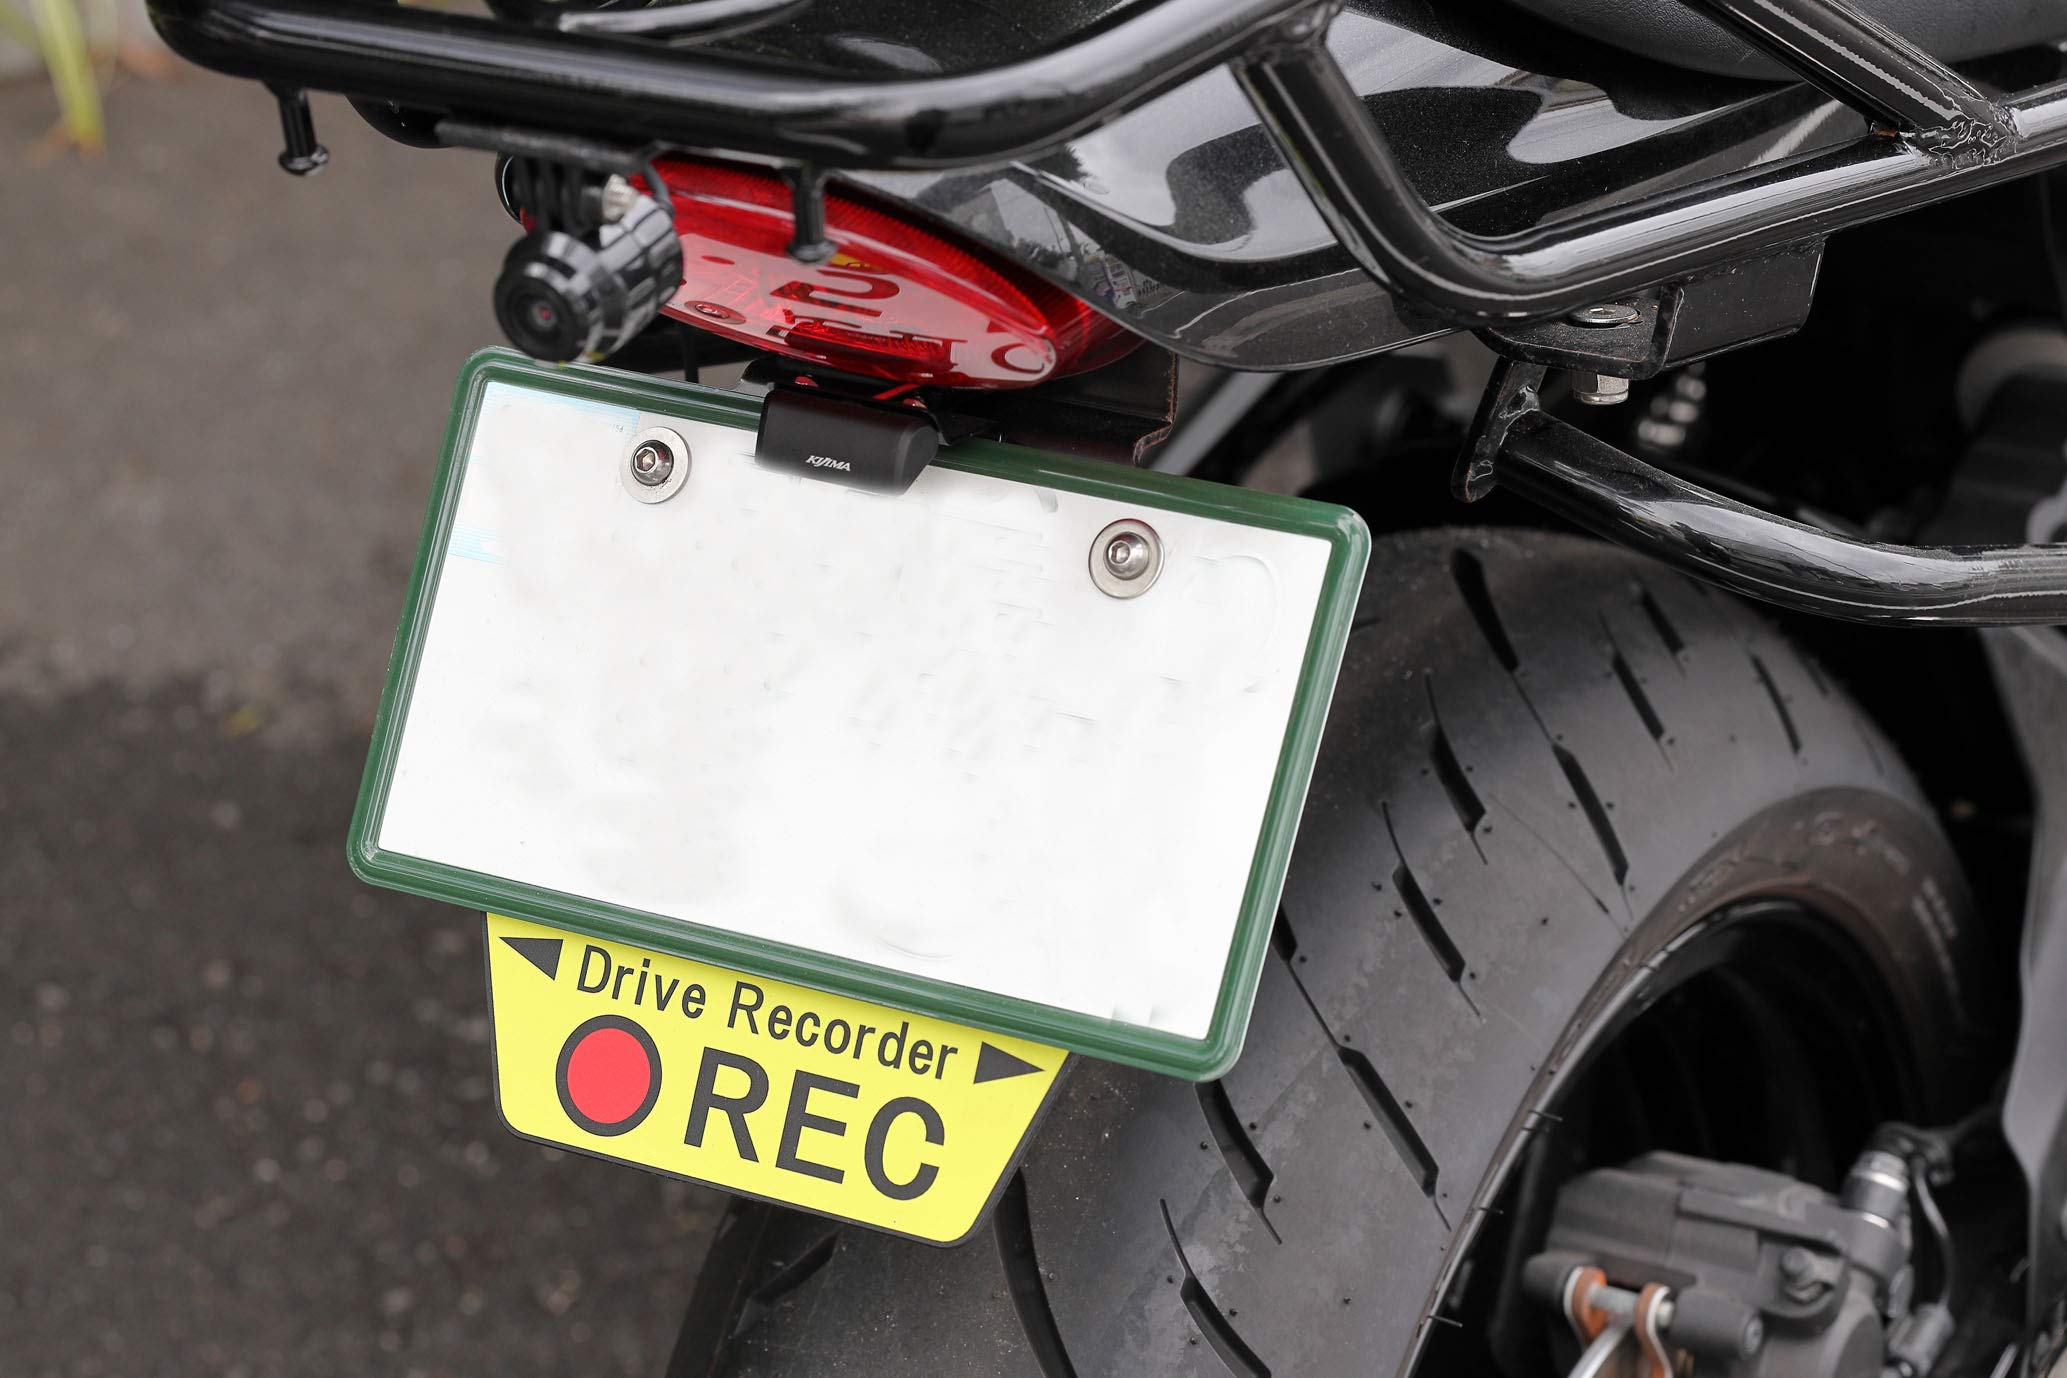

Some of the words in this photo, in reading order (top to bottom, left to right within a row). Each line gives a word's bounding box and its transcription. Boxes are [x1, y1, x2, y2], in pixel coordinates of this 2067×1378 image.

[805, 455, 851, 472] KIJIMA
[576, 944, 706, 1019] Drive
[727, 980, 959, 1080] Recorder
[683, 1046, 945, 1201] REC
